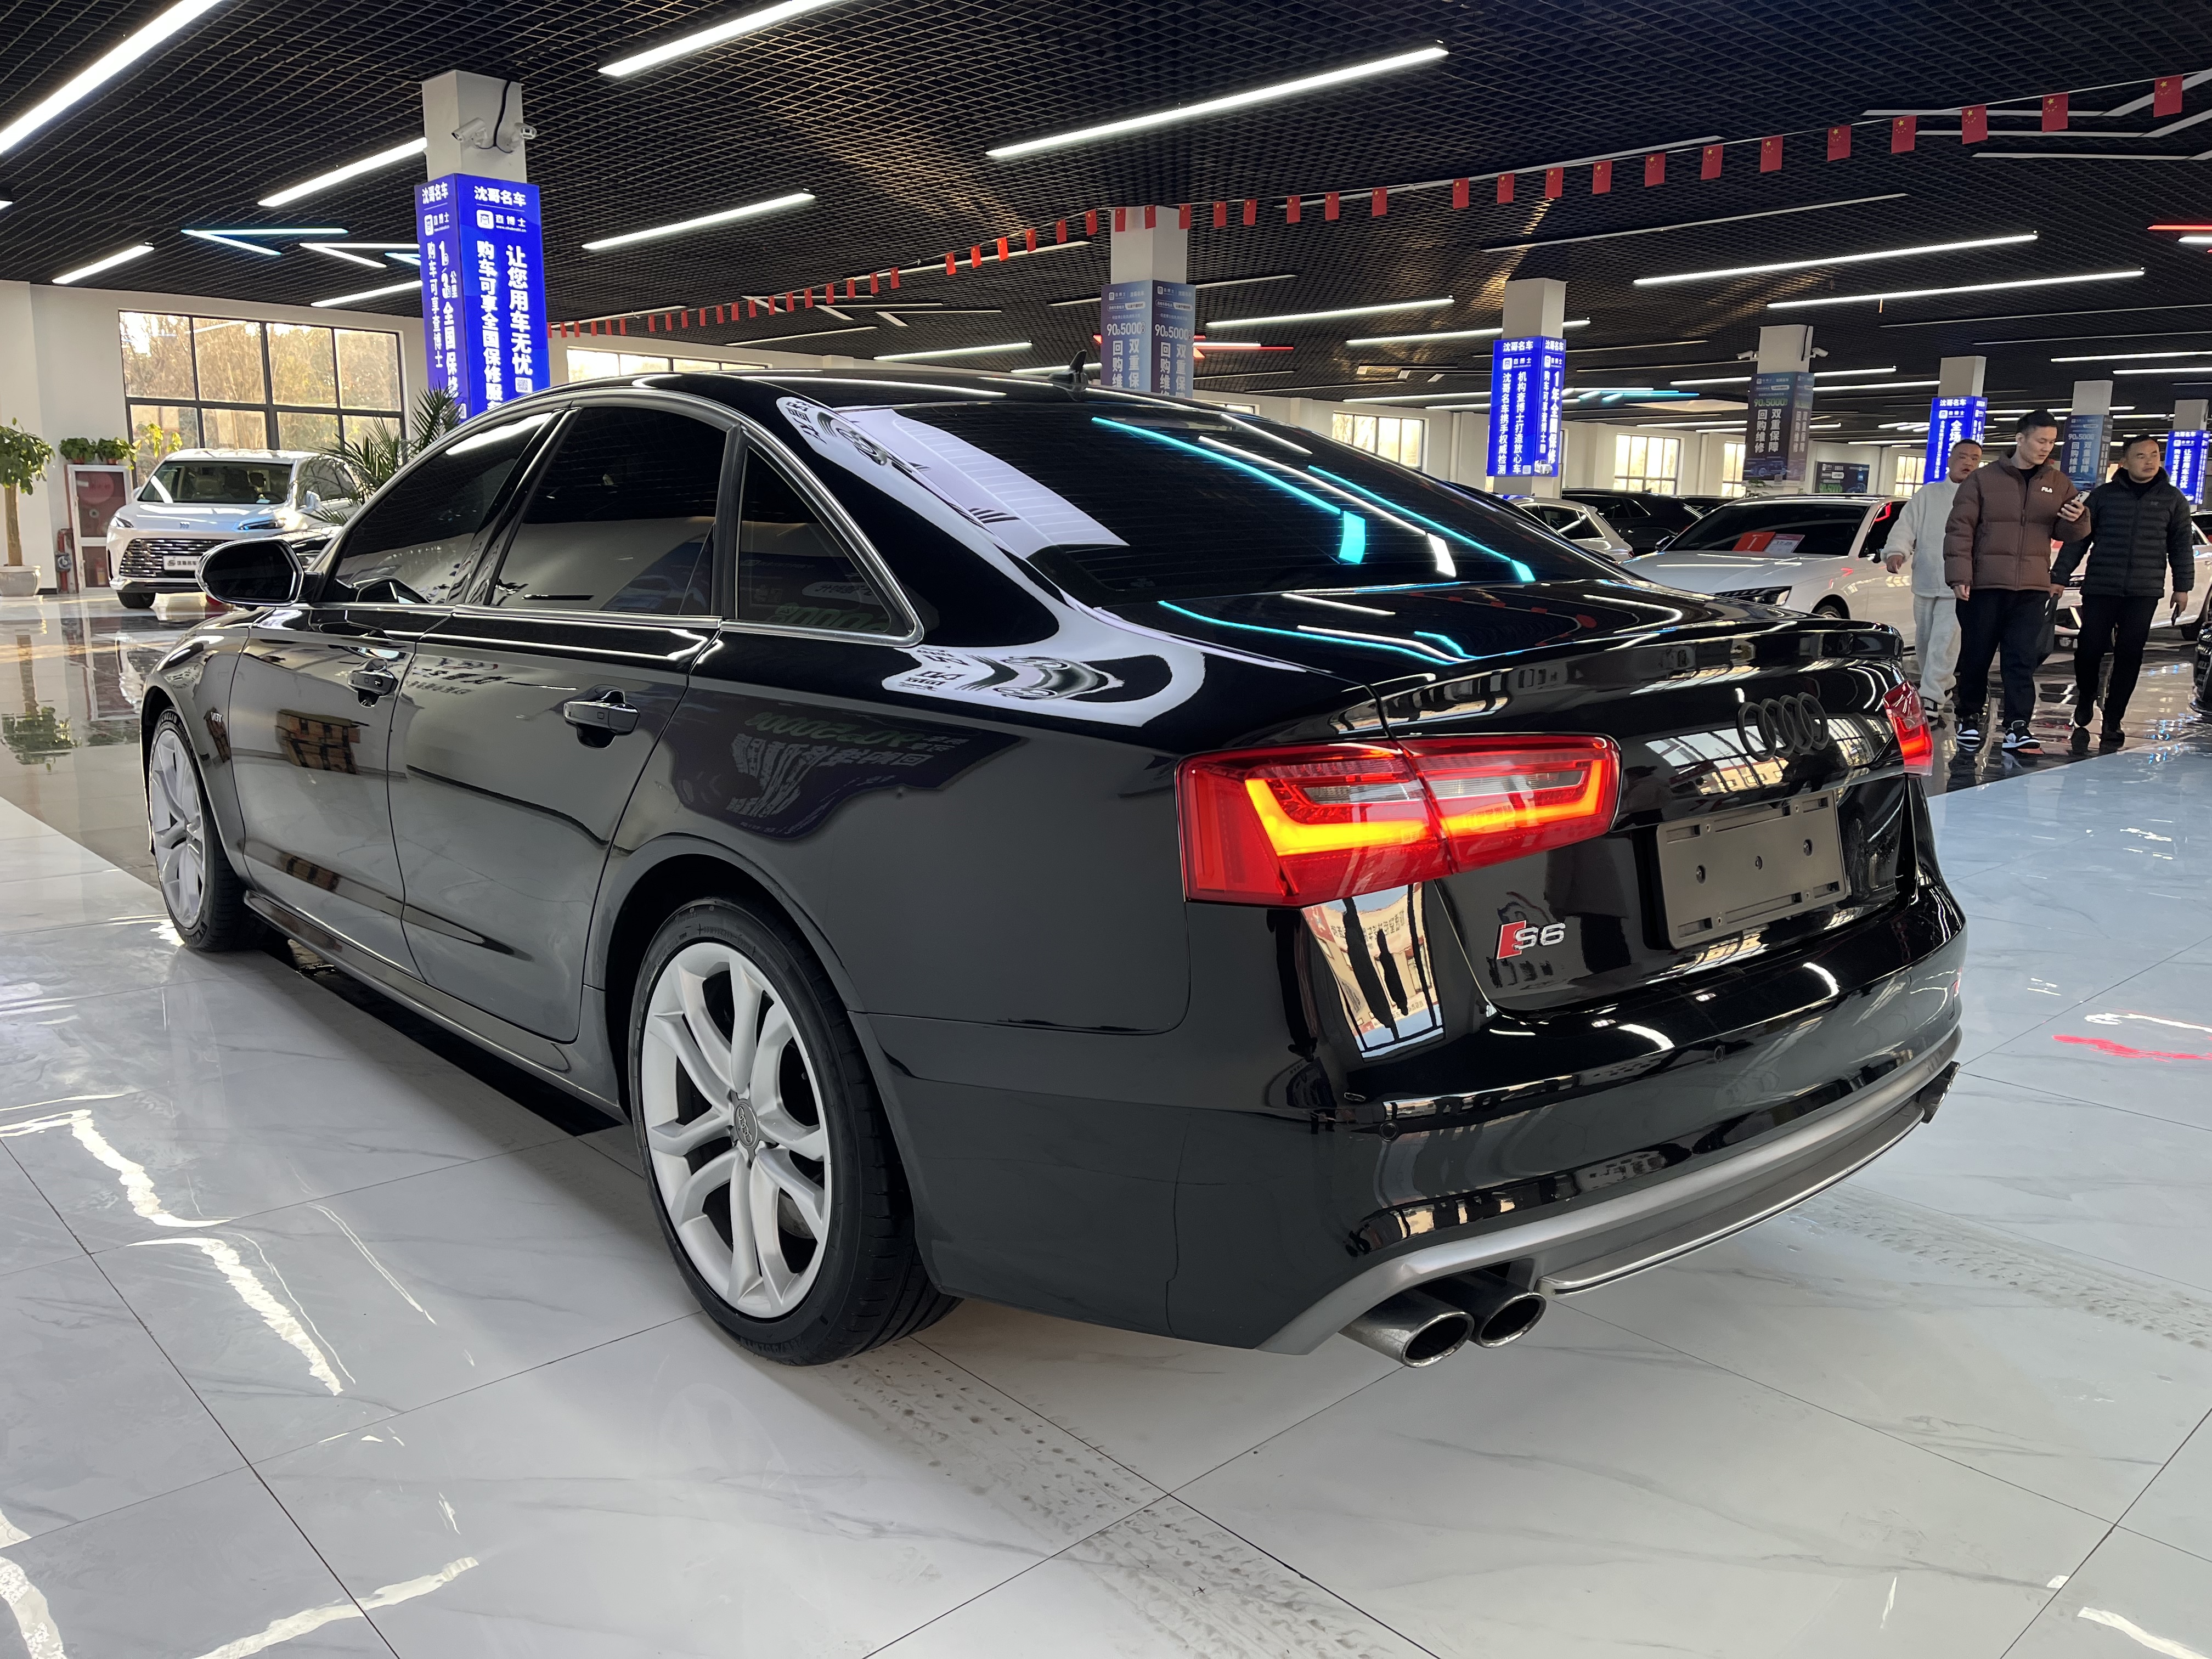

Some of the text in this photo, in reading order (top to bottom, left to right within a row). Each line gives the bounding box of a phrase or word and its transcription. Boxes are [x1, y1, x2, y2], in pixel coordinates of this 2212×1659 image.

[422, 182, 448, 204] 沈哥名车
[474, 186, 526, 207] 沈哥名车
[506, 245, 533, 375] 让您用车无忧
[1503, 340, 1533, 352] 沈哥名车
[1498, 373, 1511, 475] 沈哥名车携手权威检测
[1513, 371, 1527, 475] 机构查博士打造放心车
[1514, 922, 1566, 950] S6
